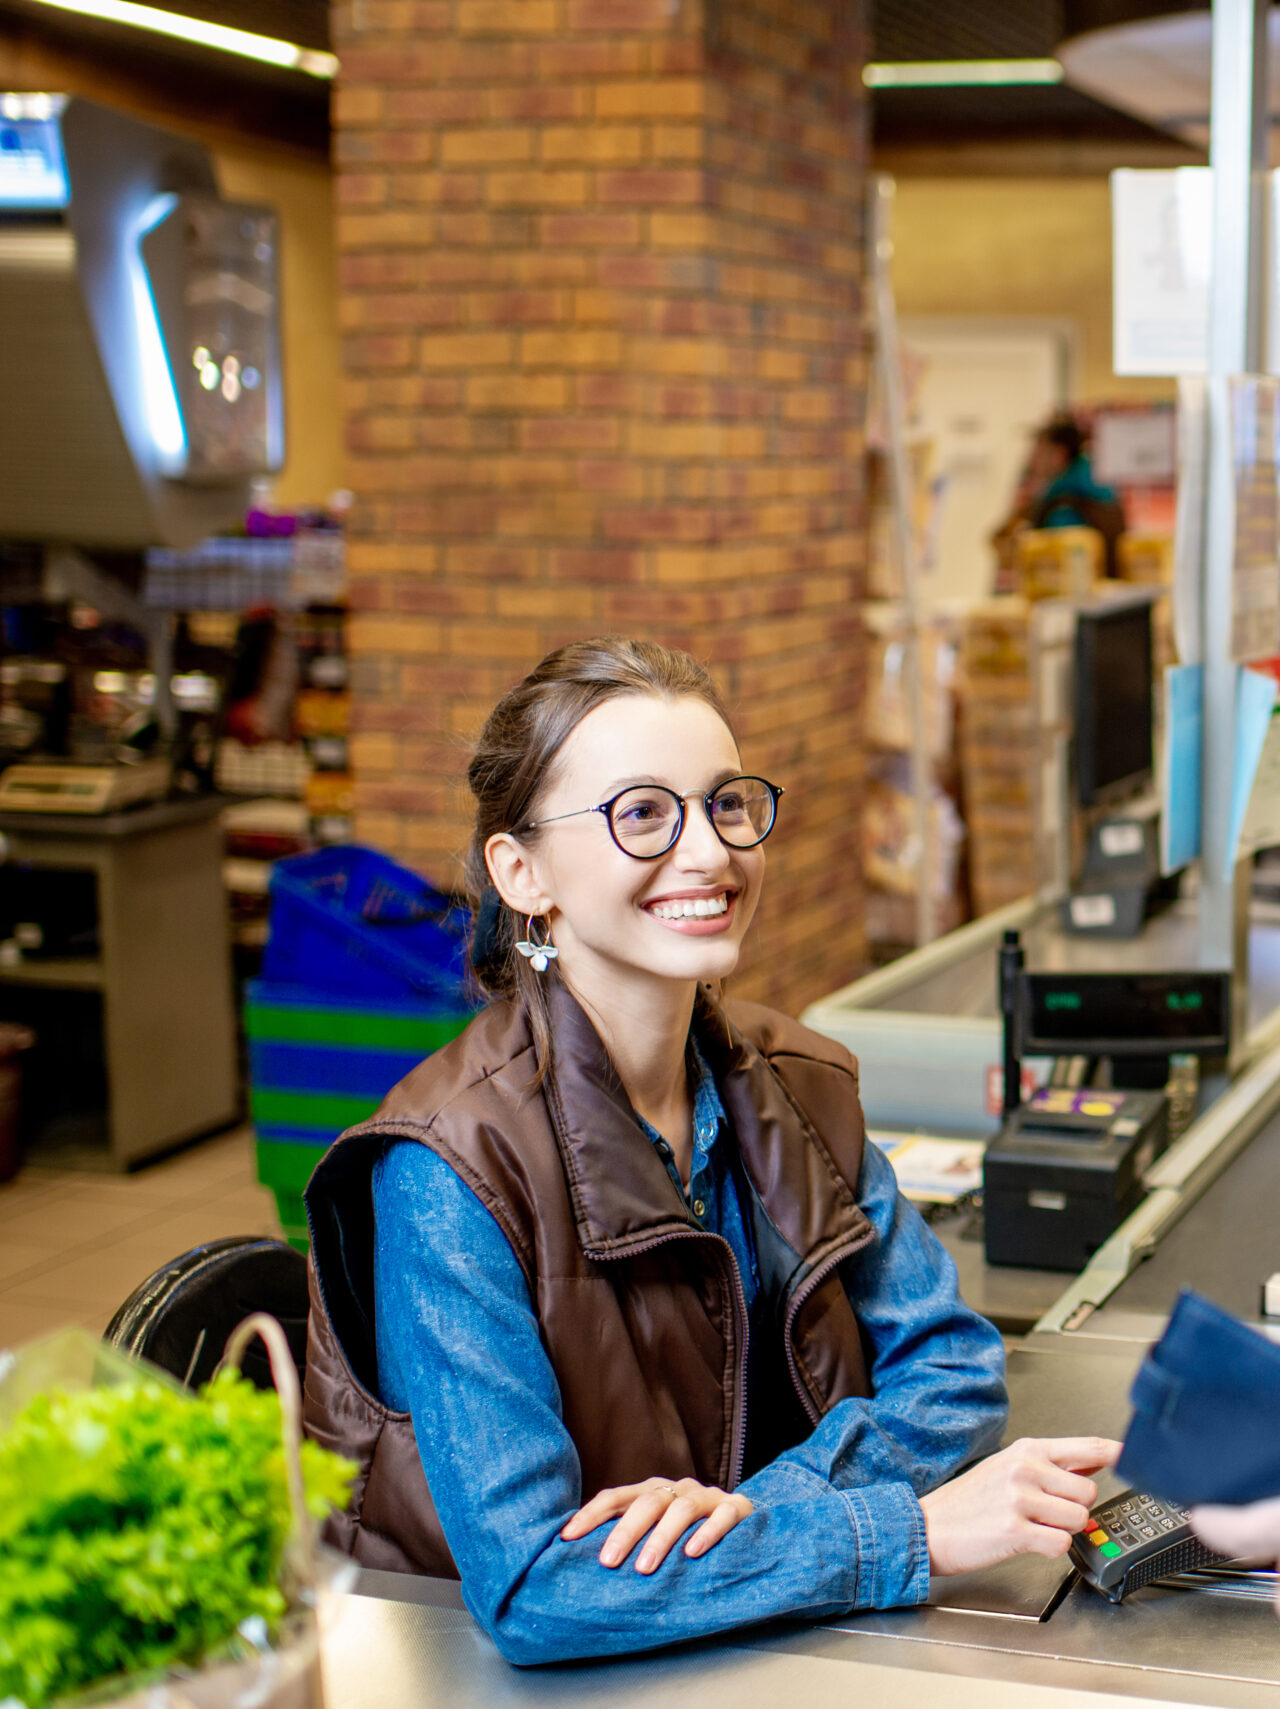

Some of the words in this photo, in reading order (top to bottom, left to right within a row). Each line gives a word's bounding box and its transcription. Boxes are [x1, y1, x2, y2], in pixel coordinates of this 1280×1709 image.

[1148, 1505, 1158, 1513] 5
[1129, 1513, 1140, 1521] 8
[1111, 1521, 1121, 1529] 0
[1160, 1518, 1171, 1526] 6
[1142, 1526, 1152, 1534] 9
